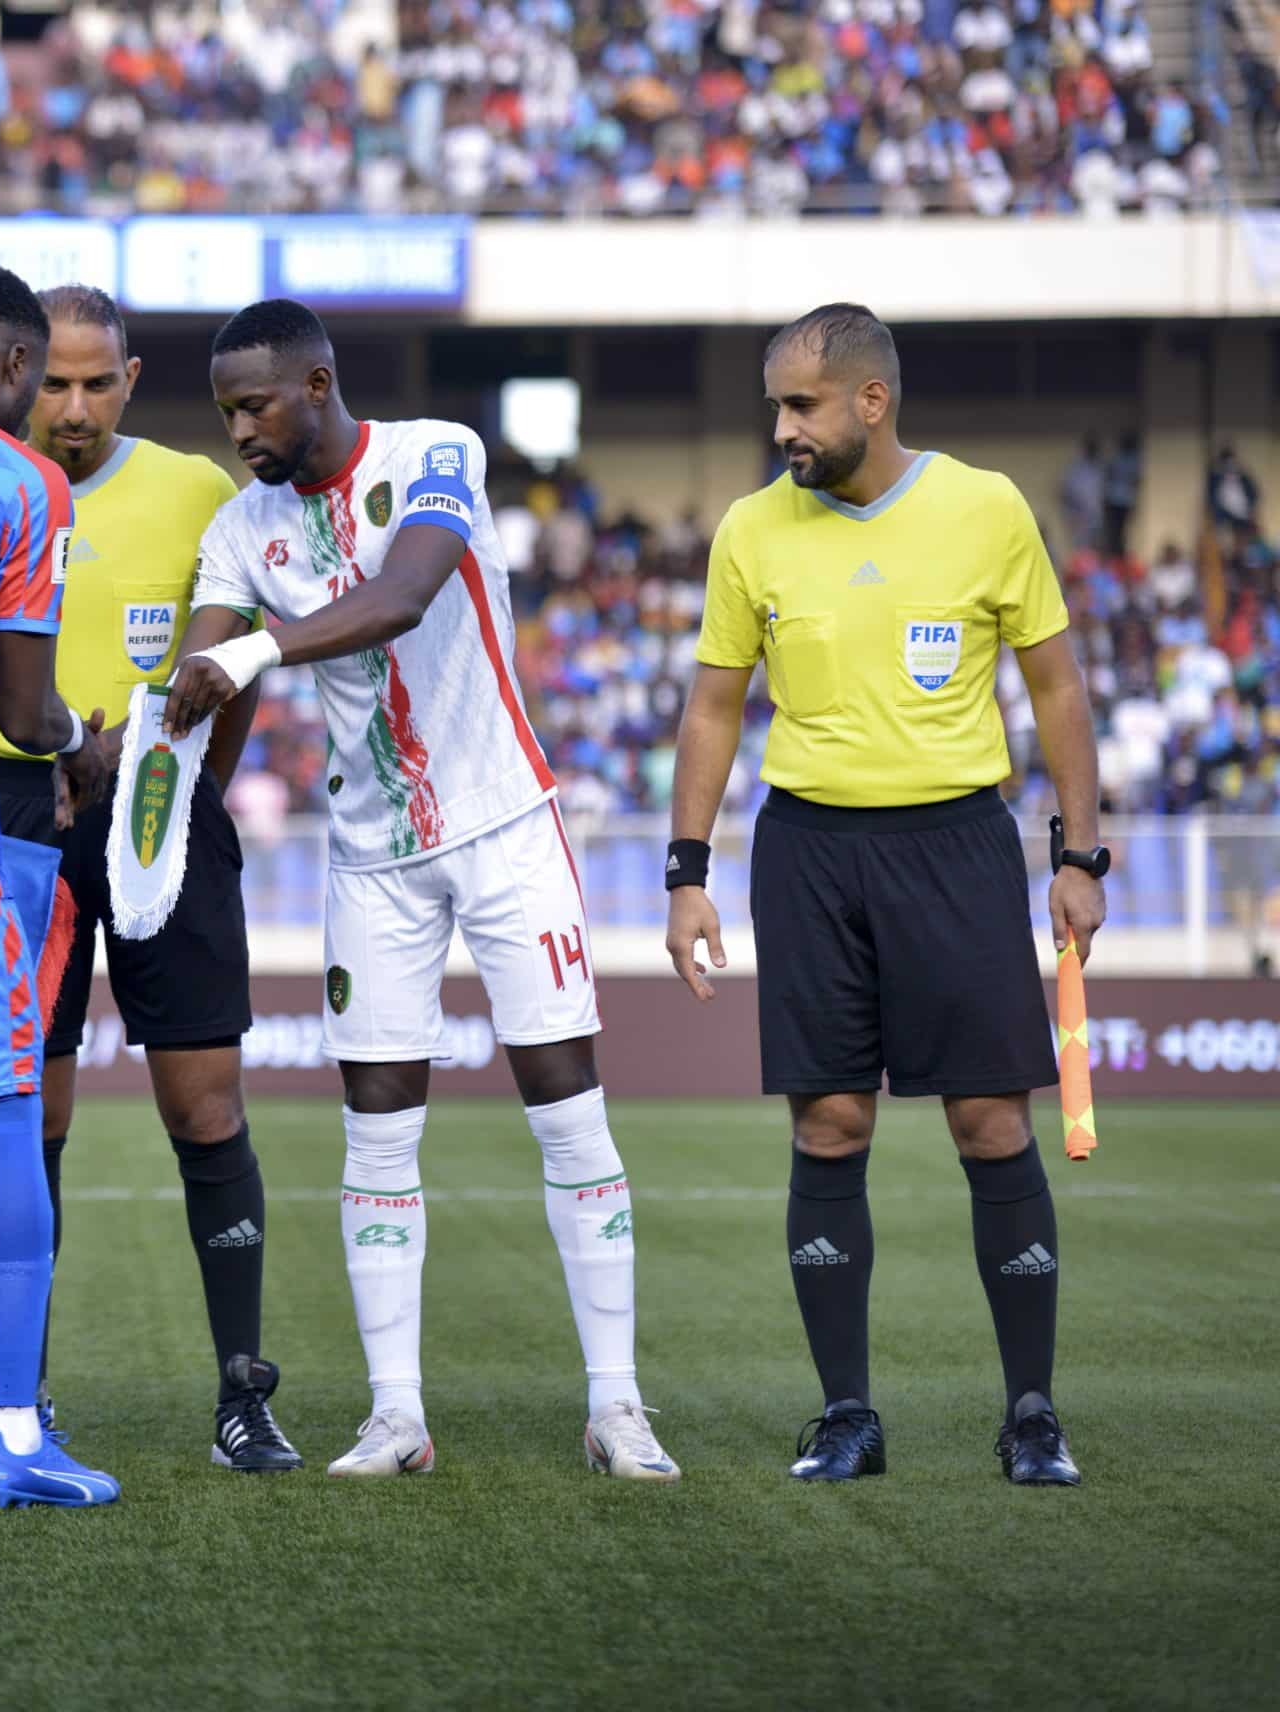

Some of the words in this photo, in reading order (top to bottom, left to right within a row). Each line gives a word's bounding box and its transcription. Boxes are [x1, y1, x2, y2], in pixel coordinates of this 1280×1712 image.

[418, 496, 461, 513] CAPTAIN
[129, 608, 171, 624] FIFA
[128, 634, 169, 645] REFEREE
[911, 626, 957, 642] FIFA
[539, 924, 590, 992] 14
[342, 1192, 420, 1208] FFRIM
[207, 1232, 264, 1247] adidas
[791, 1253, 849, 1267] adidas
[1000, 1259, 1057, 1275] adidas
